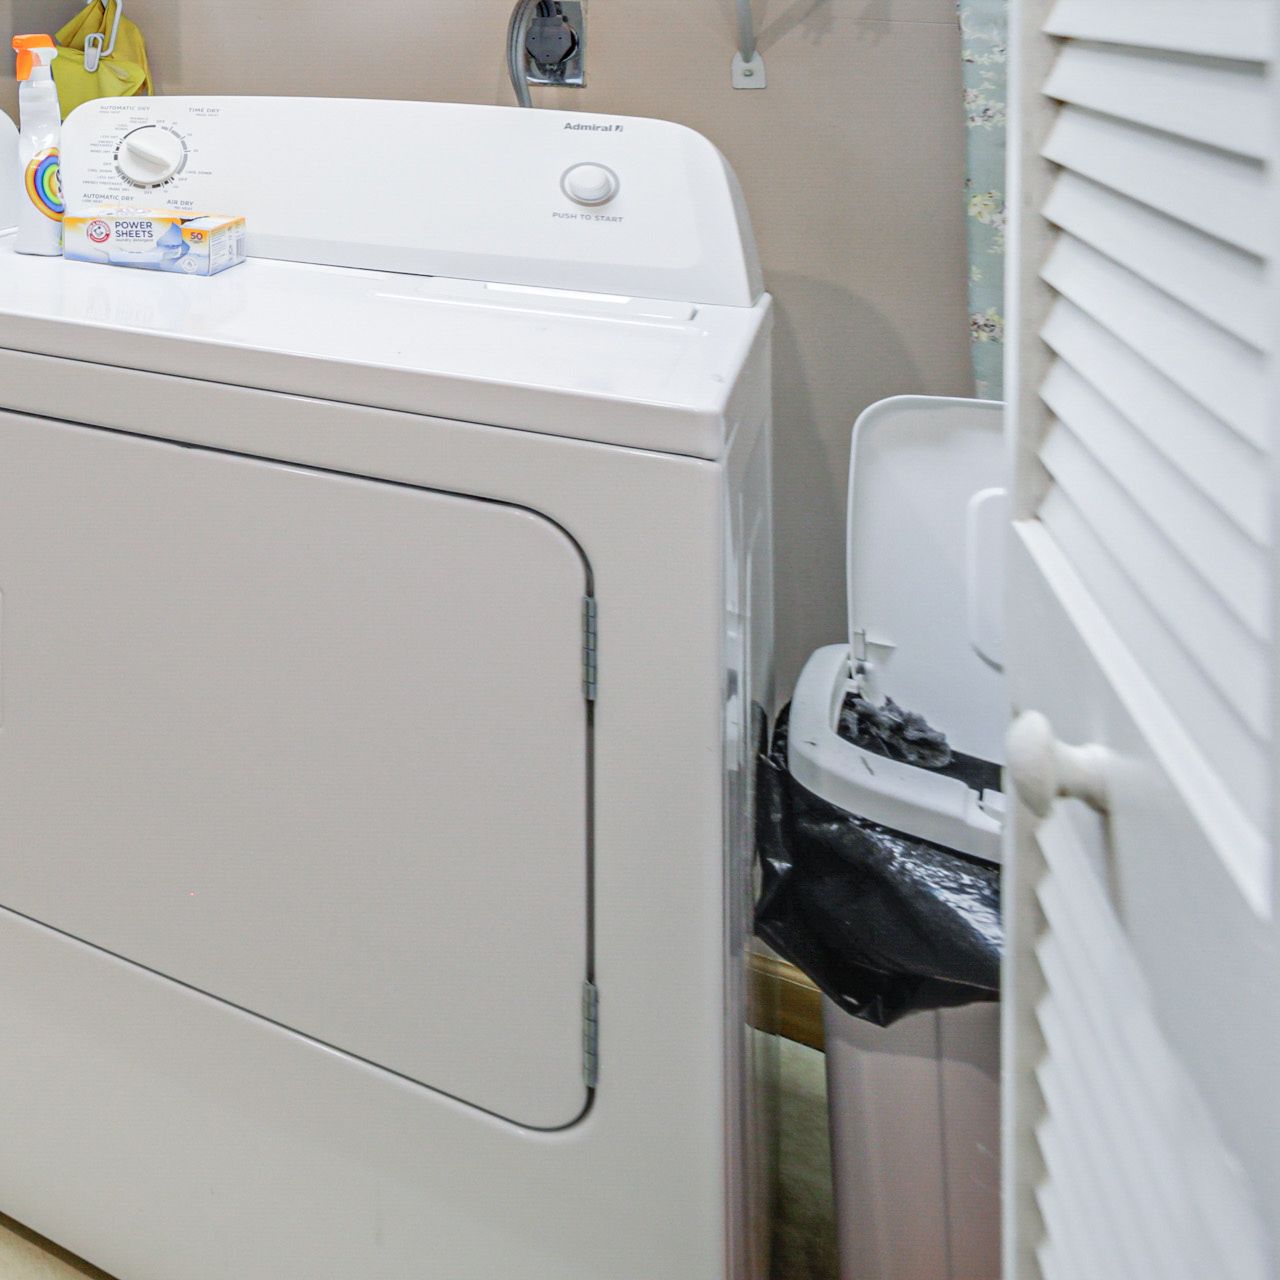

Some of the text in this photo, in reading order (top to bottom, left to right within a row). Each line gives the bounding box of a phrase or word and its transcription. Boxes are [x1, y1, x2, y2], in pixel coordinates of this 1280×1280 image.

[564, 122, 613, 132] Admiral
[83, 193, 119, 201] AUTOMATIC
[552, 211, 577, 220] PUSH
[595, 215, 624, 223] START
[115, 221, 153, 229] POWER
[115, 230, 153, 238] SHEETS
[190, 232, 203, 240] 50
